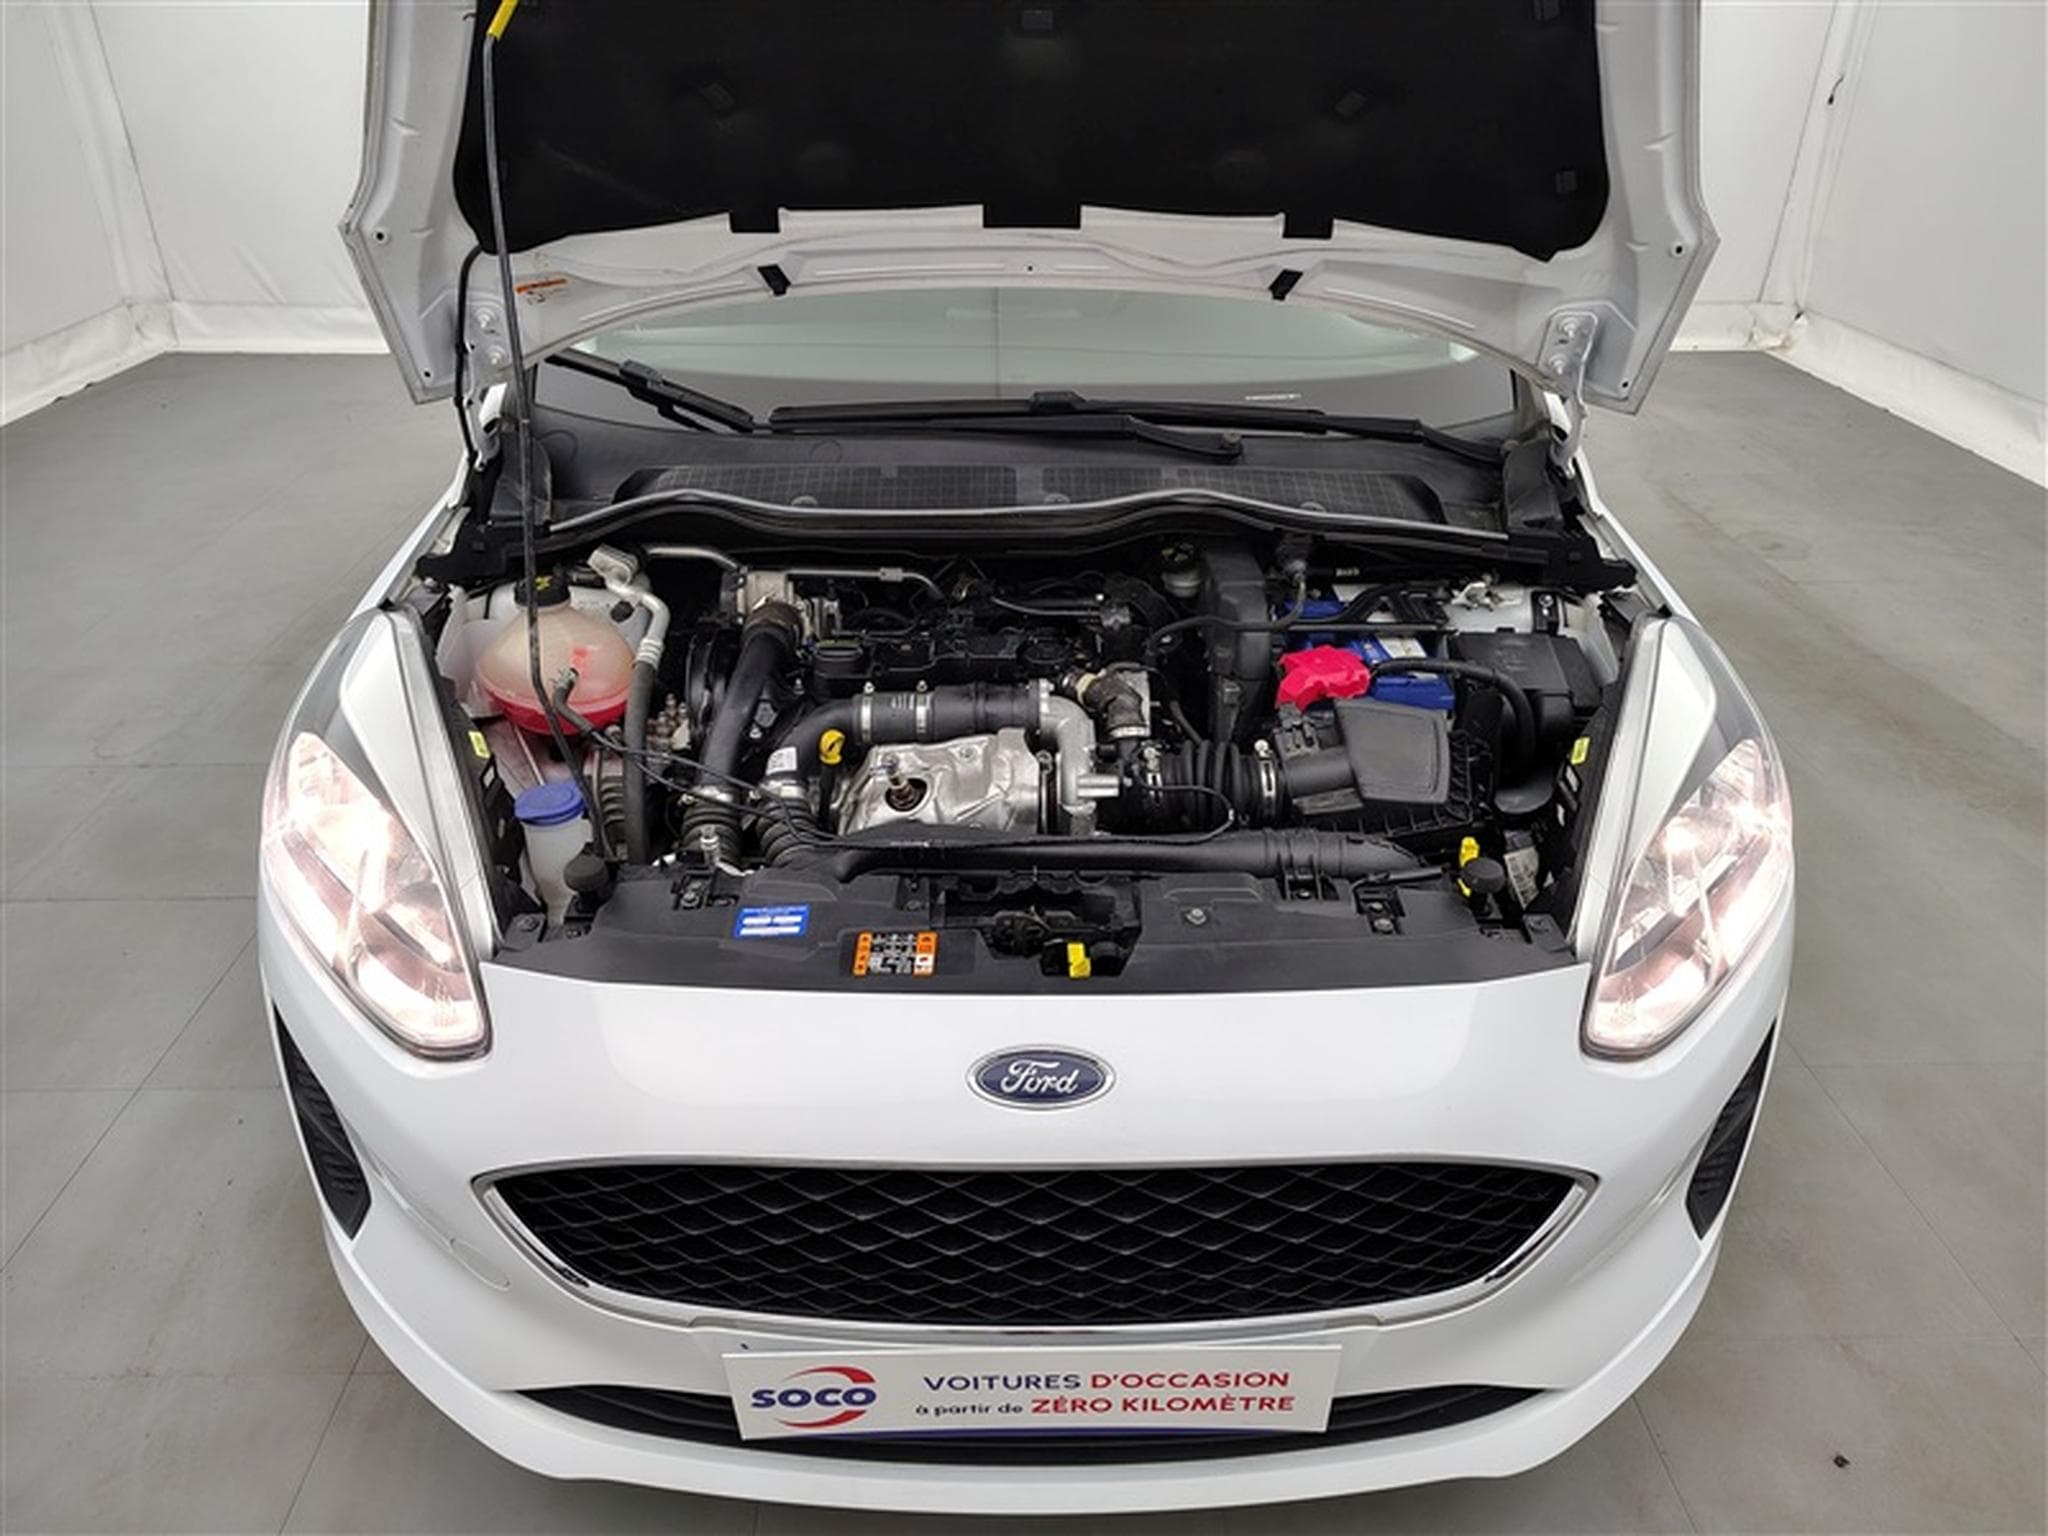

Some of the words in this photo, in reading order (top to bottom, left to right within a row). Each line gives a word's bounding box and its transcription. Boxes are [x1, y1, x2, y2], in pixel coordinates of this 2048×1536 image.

[1001, 1059, 1079, 1093] Ford
[923, 1374, 1081, 1391] VOITURES
[1091, 1372, 1289, 1389] D'OCCASION
[751, 1387, 878, 1409] SOCO
[934, 1402, 990, 1417] partir
[998, 1402, 1023, 1414] de
[1031, 1396, 1113, 1413] ZÉRO
[1121, 1393, 1295, 1412] KILOMÈTRE
